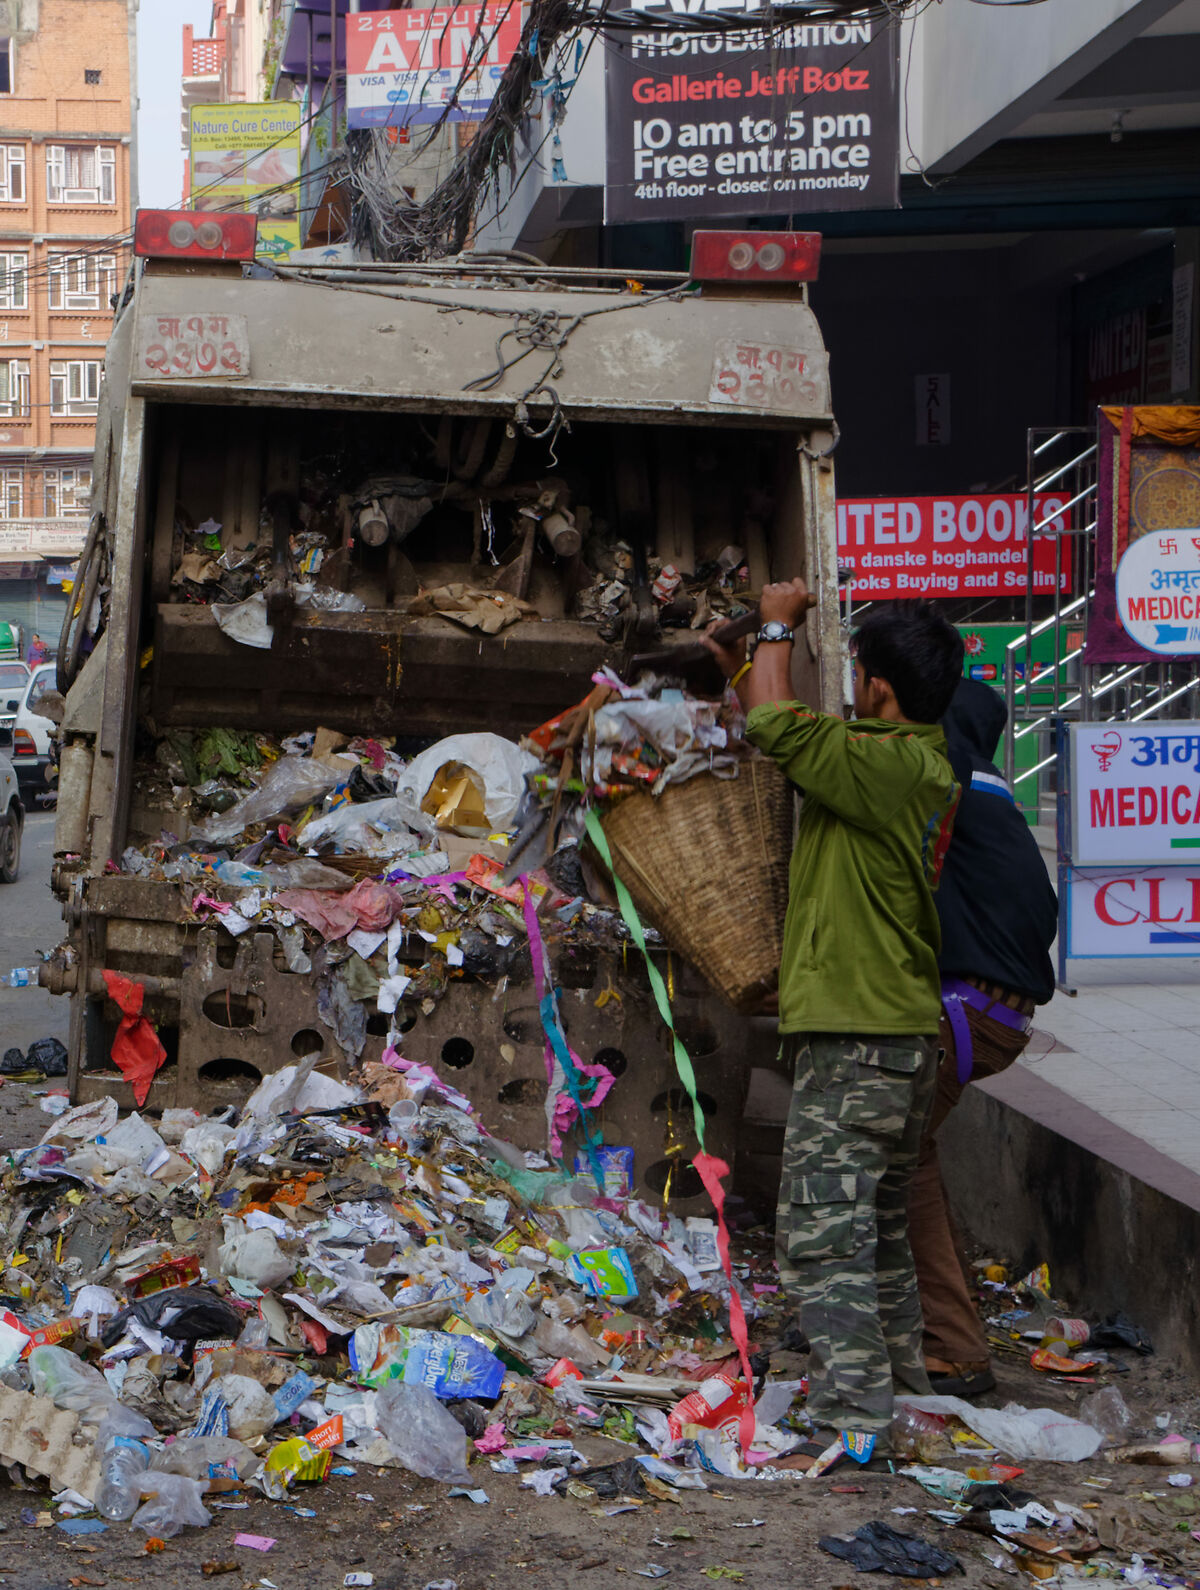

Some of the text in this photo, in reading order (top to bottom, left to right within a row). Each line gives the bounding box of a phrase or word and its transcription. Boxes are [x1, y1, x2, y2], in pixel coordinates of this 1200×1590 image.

[358, 7, 511, 31] 24 HOURS
[364, 24, 500, 72] ATM
[359, 72, 419, 86] VISA VISA
[632, 65, 870, 104] Gallerie Jeff Botz
[192, 117, 298, 135] Nature Cure Center
[633, 111, 871, 149] 10 am to 5 pm
[634, 143, 870, 180] Free entrance
[635, 182, 664, 199] 4th
[665, 180, 707, 197] floor
[717, 177, 770, 194] closed
[773, 179, 796, 191] on
[799, 173, 870, 194] monday
[837, 497, 1066, 546] ITED BOOKS
[861, 550, 927, 568] danske
[932, 547, 1028, 569] boghandel
[896, 573, 958, 592] Buying
[964, 572, 993, 587] and
[1004, 570, 1067, 588] Seling
[310, 1425, 333, 1444] Short
